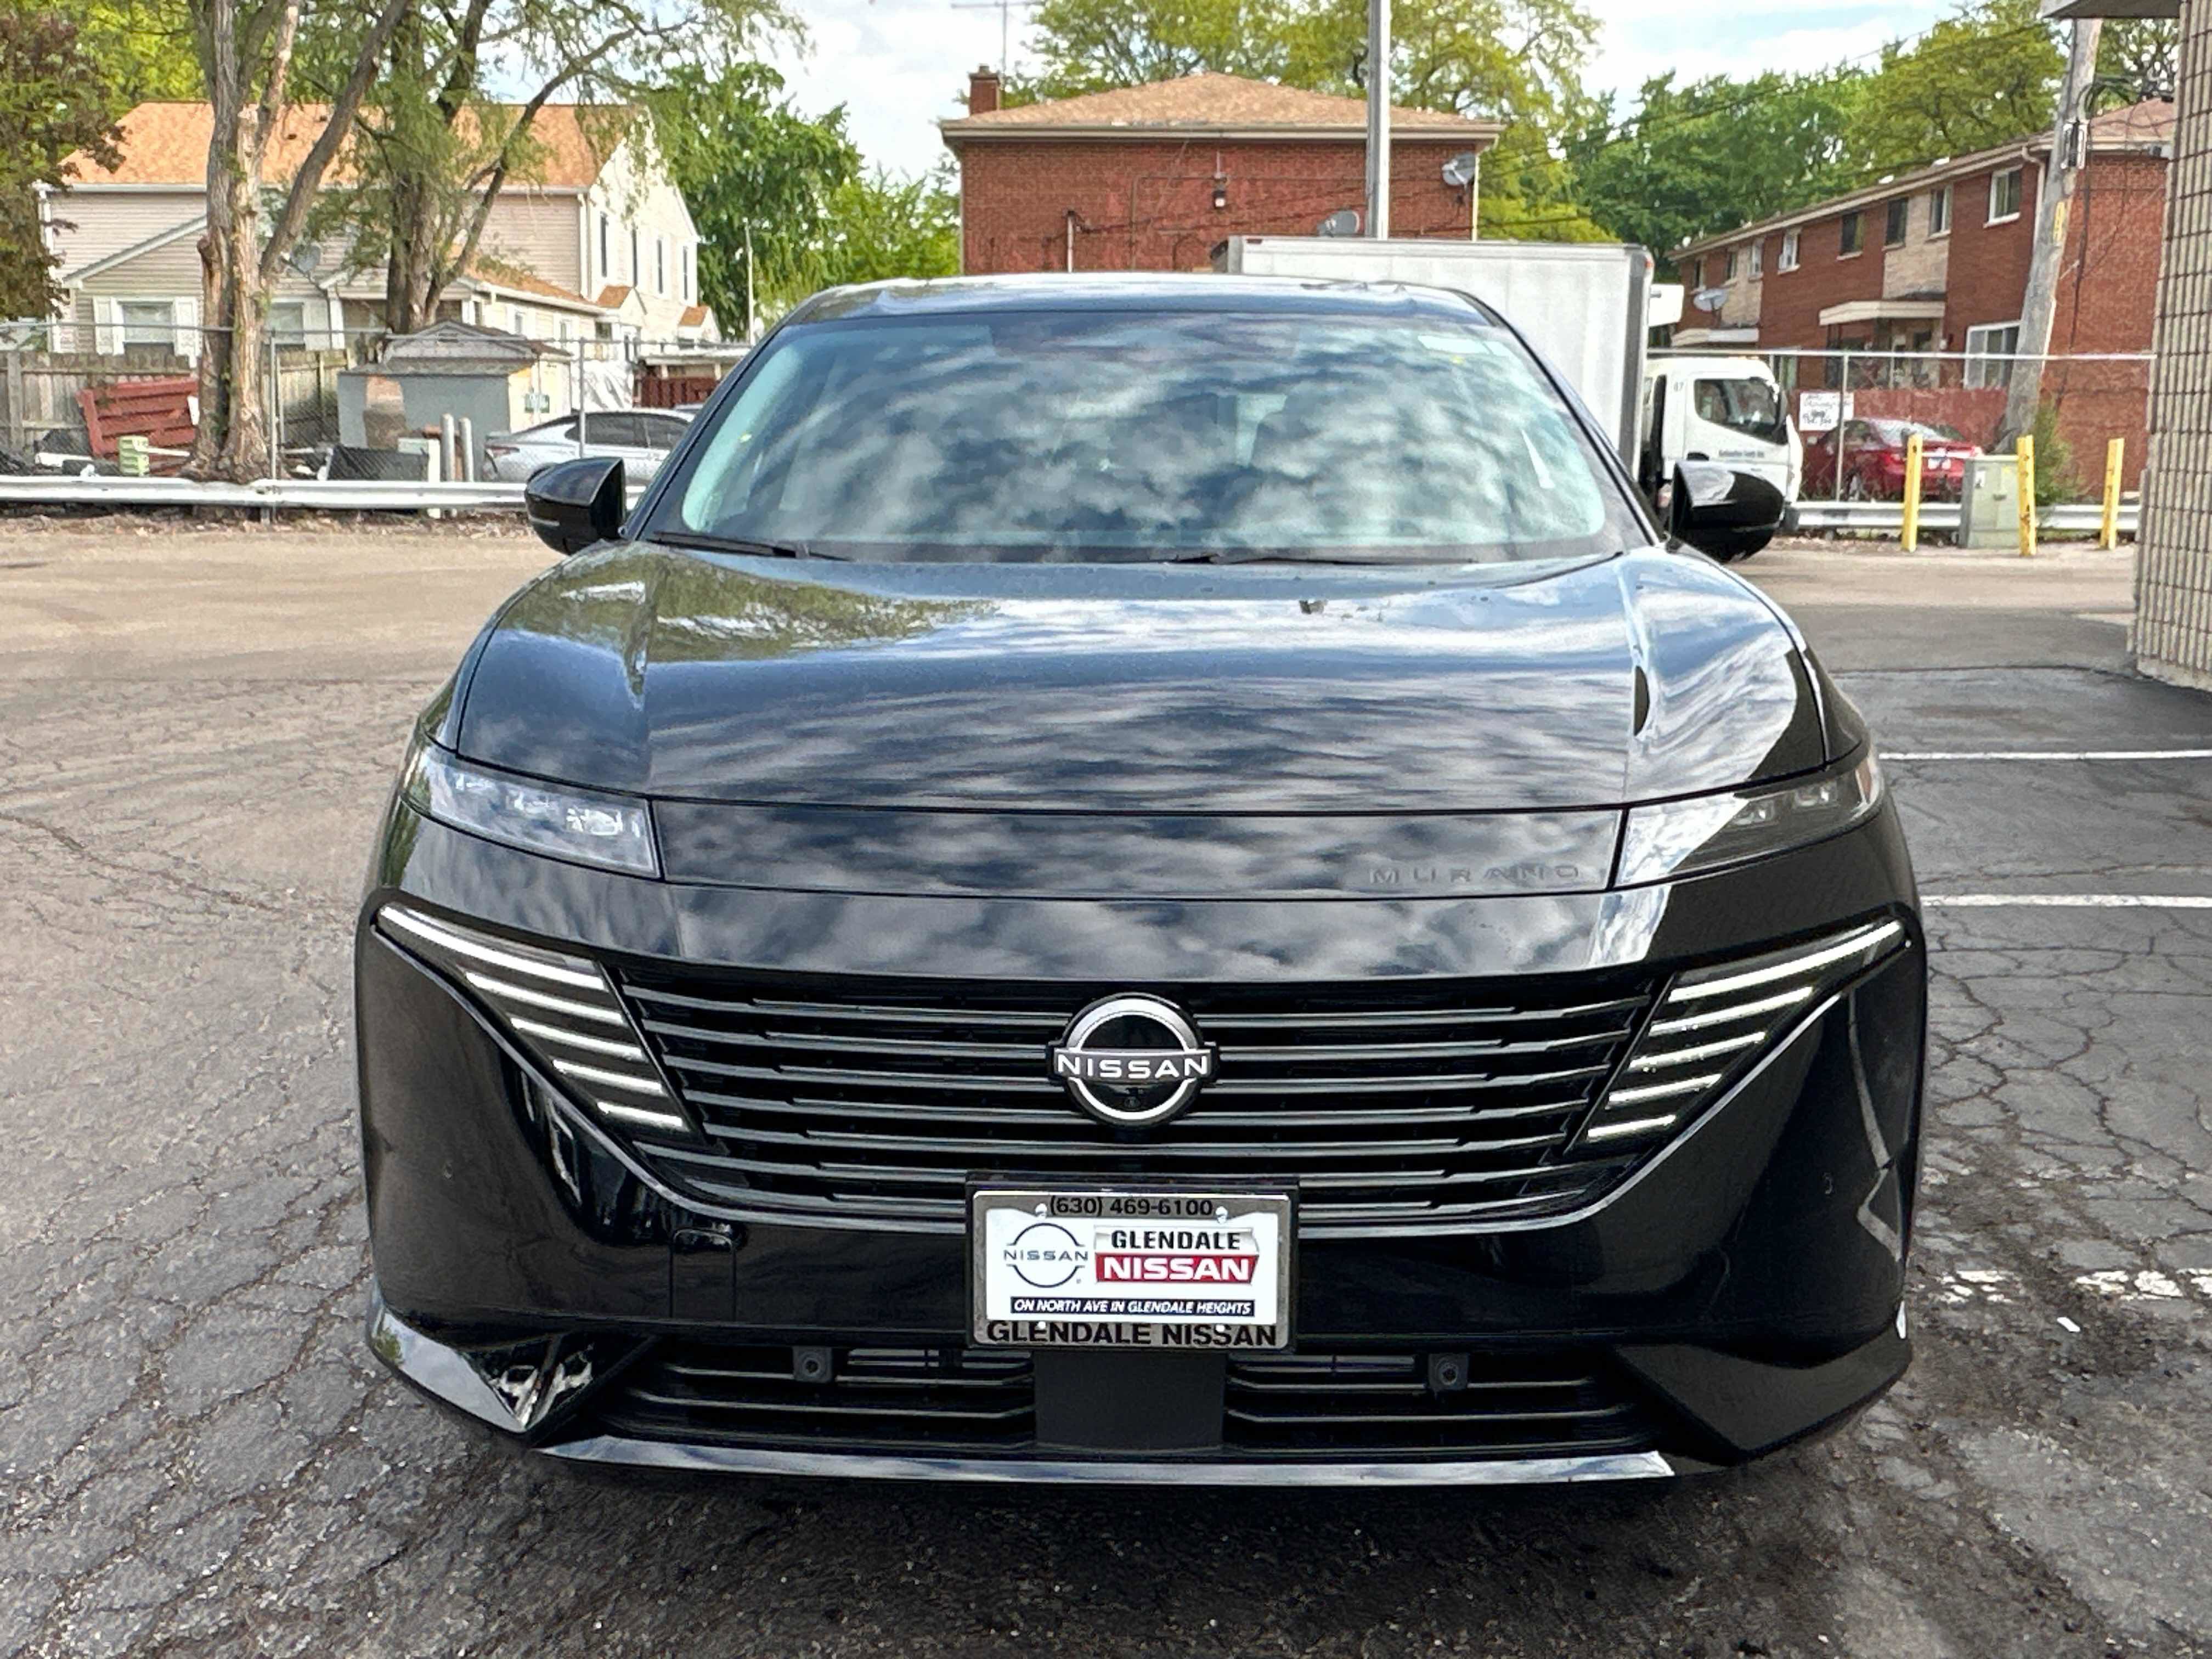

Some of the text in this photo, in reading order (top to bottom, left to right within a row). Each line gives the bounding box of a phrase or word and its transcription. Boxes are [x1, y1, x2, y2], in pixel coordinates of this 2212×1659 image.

[1372, 864, 1578, 883] MURANO
[1058, 1054, 1207, 1079] NISSAN
[1050, 1195, 1212, 1216] (630) 469-6100
[1111, 1230, 1240, 1250] GLENDALE
[1003, 1250, 1088, 1261] NISSAN
[1104, 1256, 1249, 1280] NISSAN
[1014, 1299, 1252, 1315] ON NORTH AVE IN GLENDALE HEIGHTS
[988, 1321, 1276, 1346] GLENDALE NISSAN
